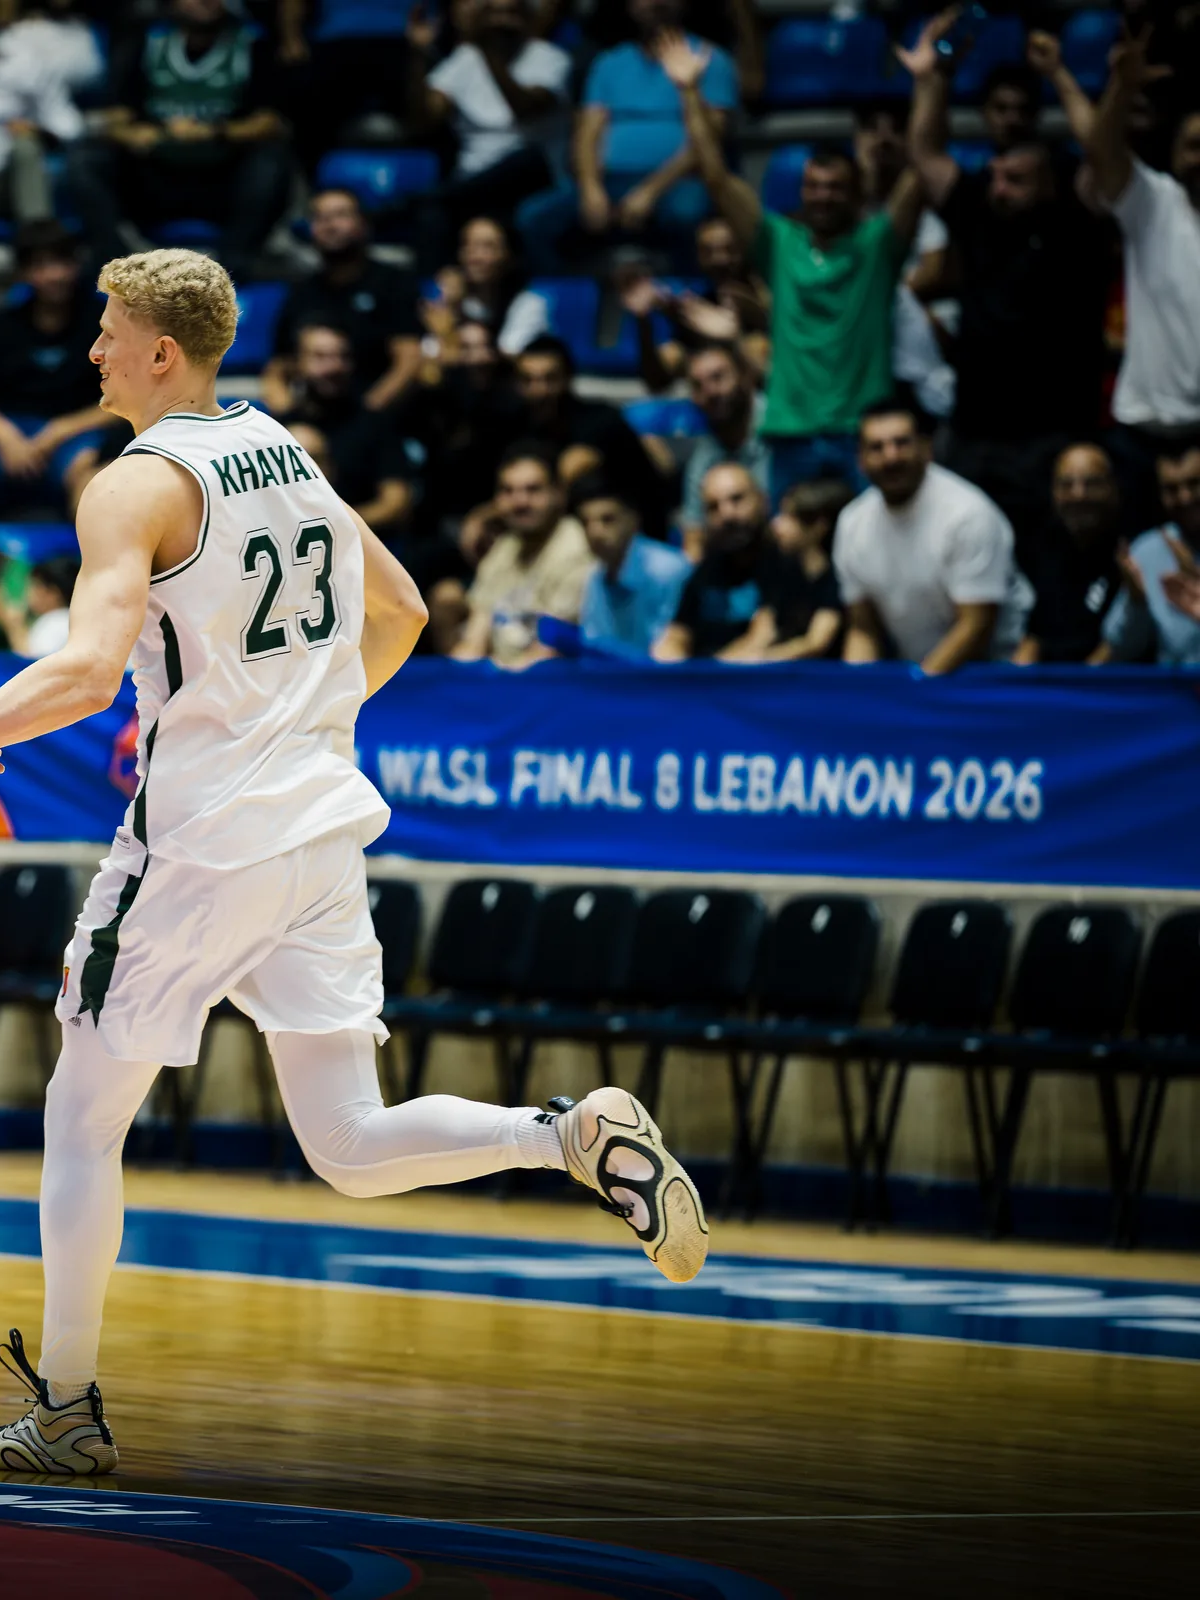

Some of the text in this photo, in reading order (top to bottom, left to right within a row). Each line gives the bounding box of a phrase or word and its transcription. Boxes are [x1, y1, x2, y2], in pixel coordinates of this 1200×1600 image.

[239, 517, 343, 662] 23
[377, 747, 1043, 820] WASL FINAL 8 LEBANON 2026
